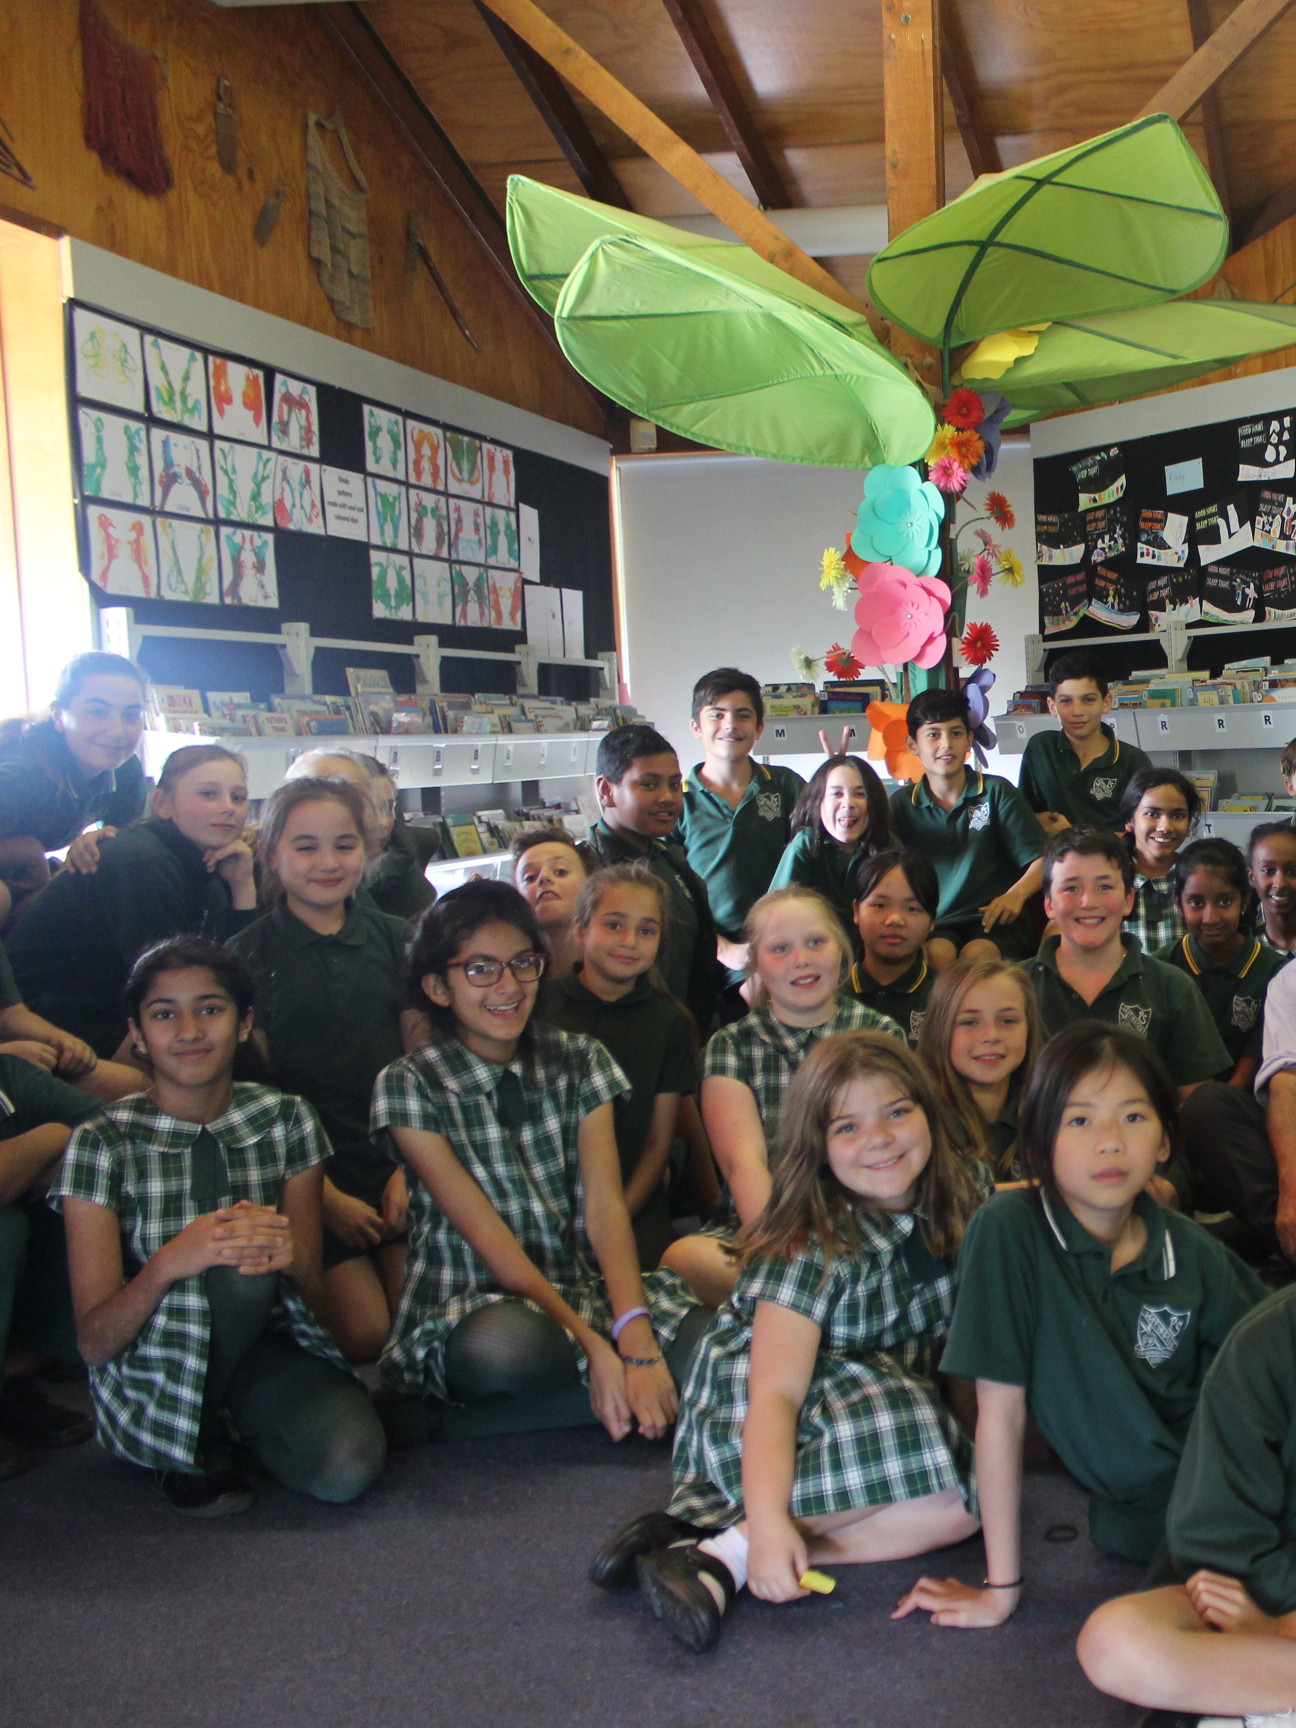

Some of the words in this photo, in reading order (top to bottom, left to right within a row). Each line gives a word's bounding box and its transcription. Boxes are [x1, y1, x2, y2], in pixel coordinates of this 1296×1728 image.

[1218, 718, 1225, 729] R
[1264, 715, 1272, 725] R
[1161, 720, 1168, 731] R
[775, 729, 786, 738] M
[1205, 824, 1212, 834] T
[1169, 1316, 1183, 1337] PS
